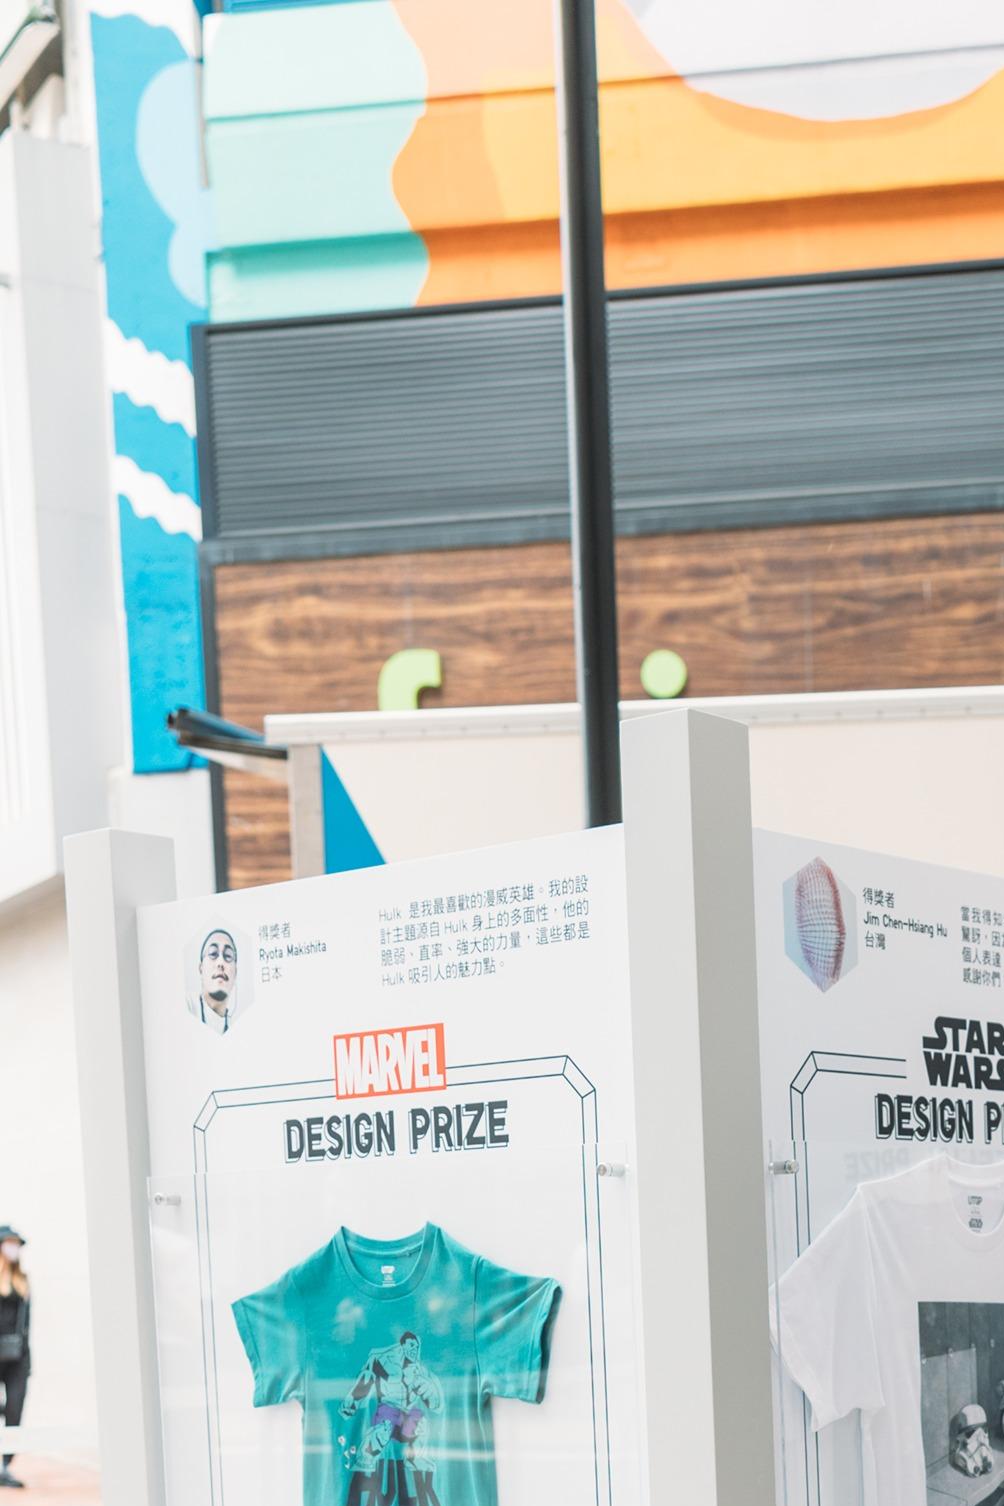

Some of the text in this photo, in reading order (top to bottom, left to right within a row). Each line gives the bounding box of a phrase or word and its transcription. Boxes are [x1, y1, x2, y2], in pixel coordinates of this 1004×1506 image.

[862, 886, 895, 909] 得獎者
[379, 907, 402, 922] Hulk
[443, 917, 469, 935] Hulk
[863, 910, 948, 939] Jim Chen-Hsiang Hu
[258, 940, 328, 963] Ryota Makishita
[864, 930, 886, 950] 台灣
[261, 966, 283, 983] 日本
[381, 973, 406, 987] Hulk
[335, 1025, 445, 1098] MARVEL
[875, 1093, 974, 1144] DESIGN
[283, 1100, 510, 1164] DESIGN PRIZE
